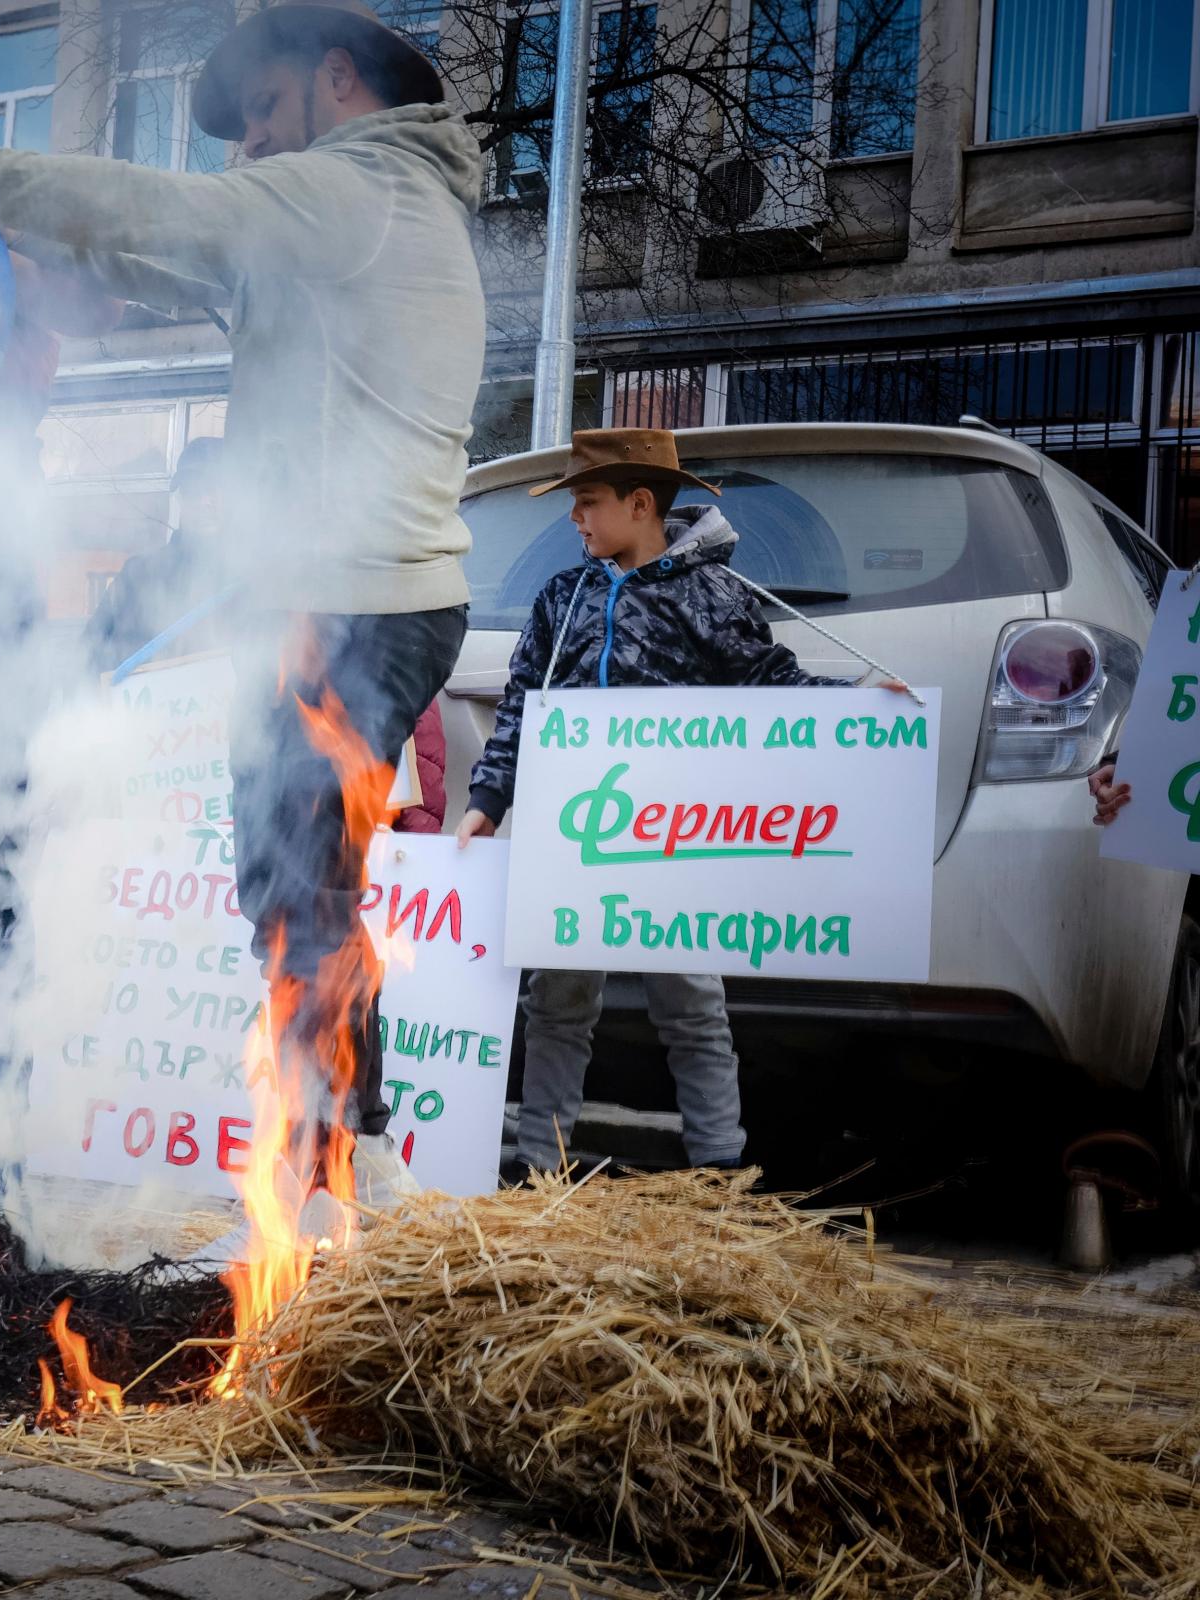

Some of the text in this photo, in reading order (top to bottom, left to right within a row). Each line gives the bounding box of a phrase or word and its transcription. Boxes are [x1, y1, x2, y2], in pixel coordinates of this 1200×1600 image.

[145, 719, 229, 761] ХУМ
[539, 707, 928, 749] Аз искам да съм
[126, 759, 232, 797] ОТНОШЕ
[558, 762, 853, 866] Фермер
[553, 894, 851, 970] в България
[82, 934, 243, 975] ОЕТО СЕ
[61, 1033, 99, 1068] СЕ
